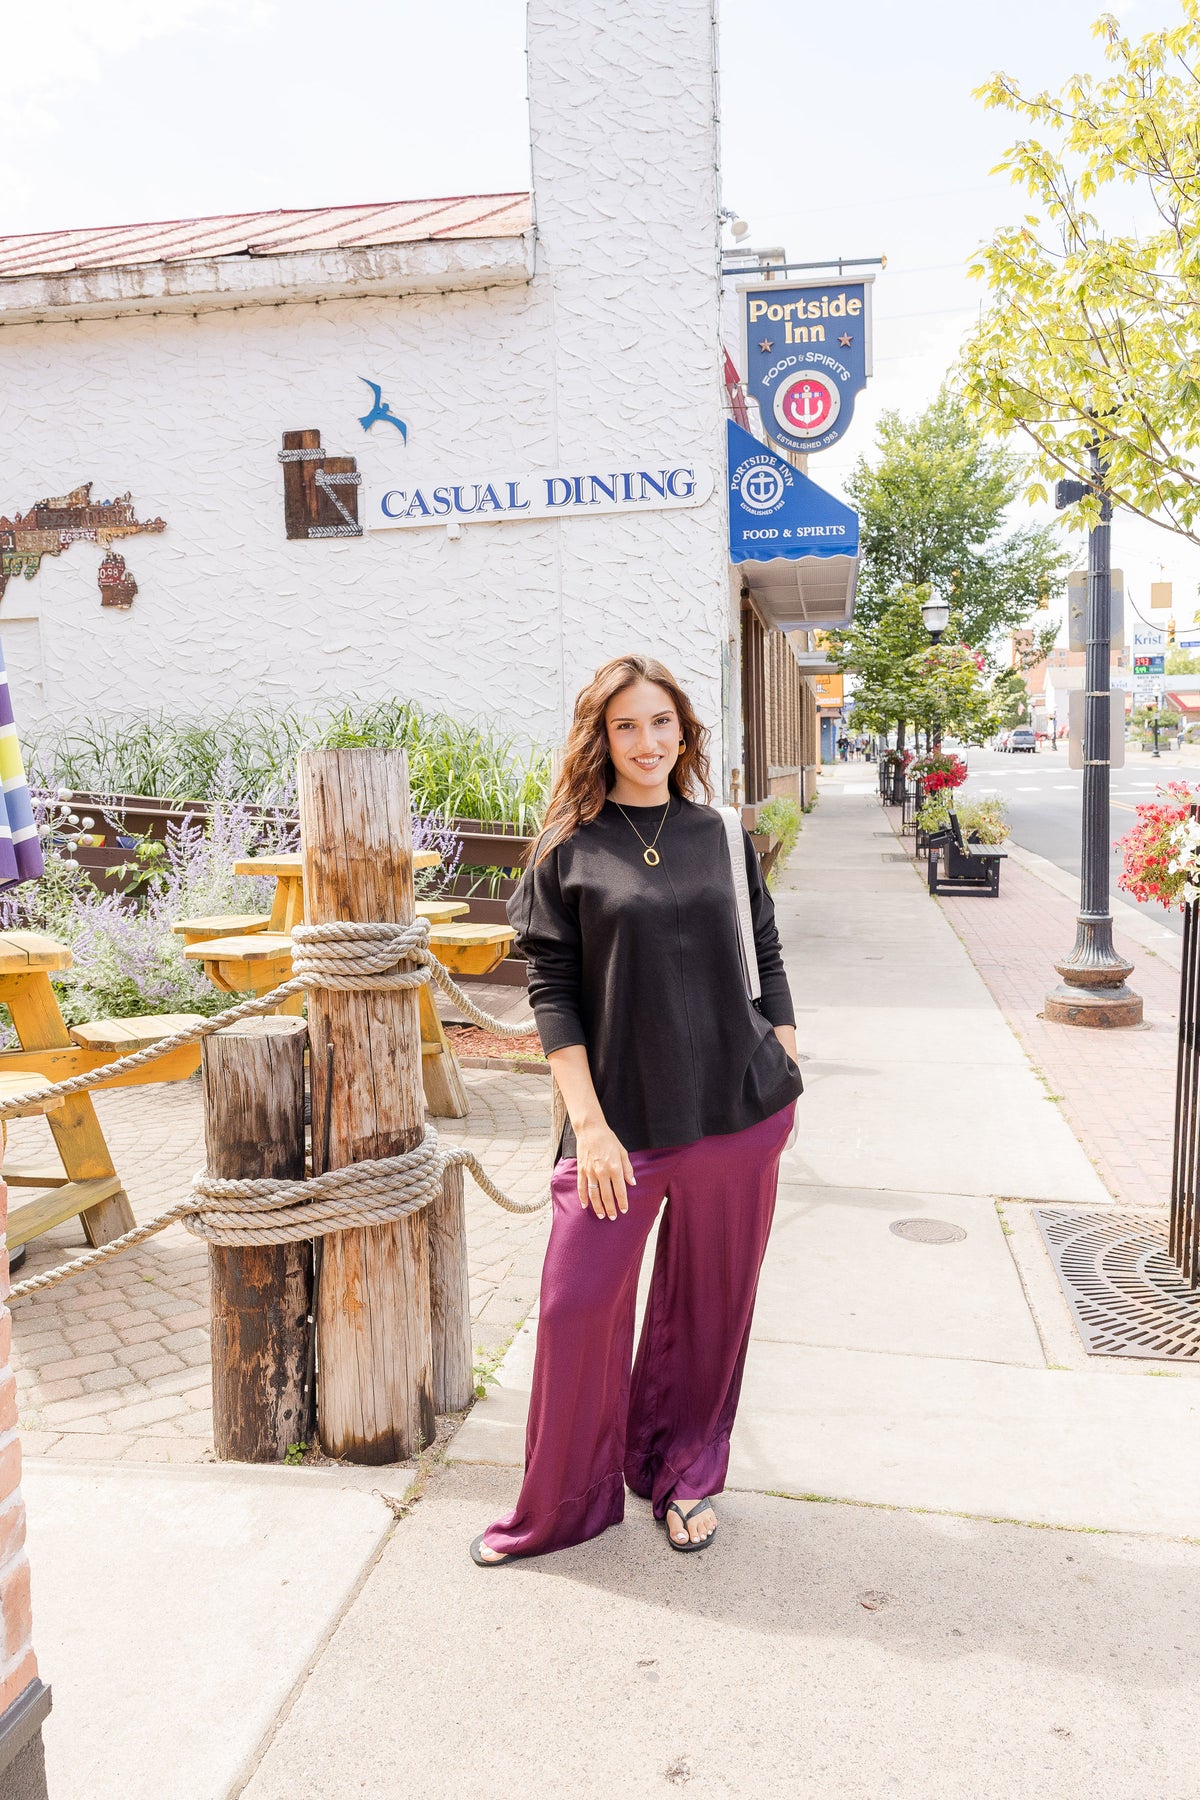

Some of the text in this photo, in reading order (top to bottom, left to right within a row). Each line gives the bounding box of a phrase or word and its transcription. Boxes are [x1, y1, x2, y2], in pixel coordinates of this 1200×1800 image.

[749, 293, 862, 323] Portside
[784, 321, 826, 344] Inn
[762, 355, 797, 386] FOOD
[805, 351, 851, 382] SPIRITS
[776, 432, 822, 450] ESTABLISHED
[731, 455, 795, 491] PORTSIDE INN
[380, 467, 697, 520] CASUAL DINING
[740, 502, 773, 516] ESTABLISHED
[742, 525, 846, 540] FOOD & SPIRITS
[1134, 633, 1162, 645] Krist
